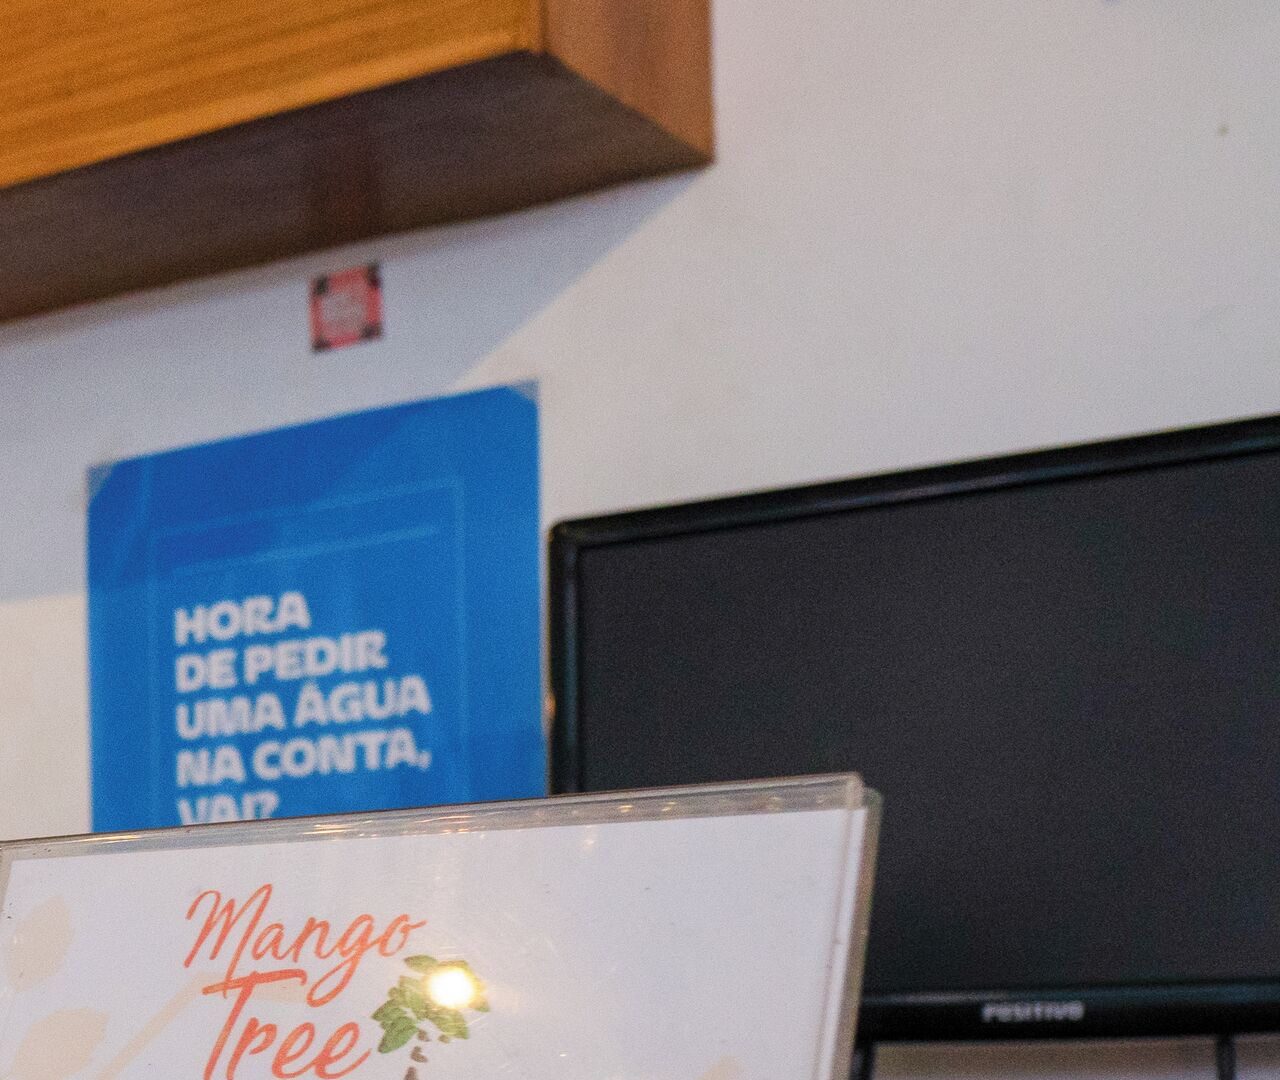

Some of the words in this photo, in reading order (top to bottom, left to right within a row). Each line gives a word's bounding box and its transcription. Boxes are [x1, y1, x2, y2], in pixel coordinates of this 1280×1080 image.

[175, 591, 312, 645] HORA
[176, 650, 237, 693] DE
[244, 630, 387, 684] PEDIR
[176, 693, 285, 739] UMA
[294, 675, 431, 728] ÁGUA
[177, 746, 245, 787] NA
[253, 728, 431, 780] CONTA,
[183, 883, 426, 1004] Mango
